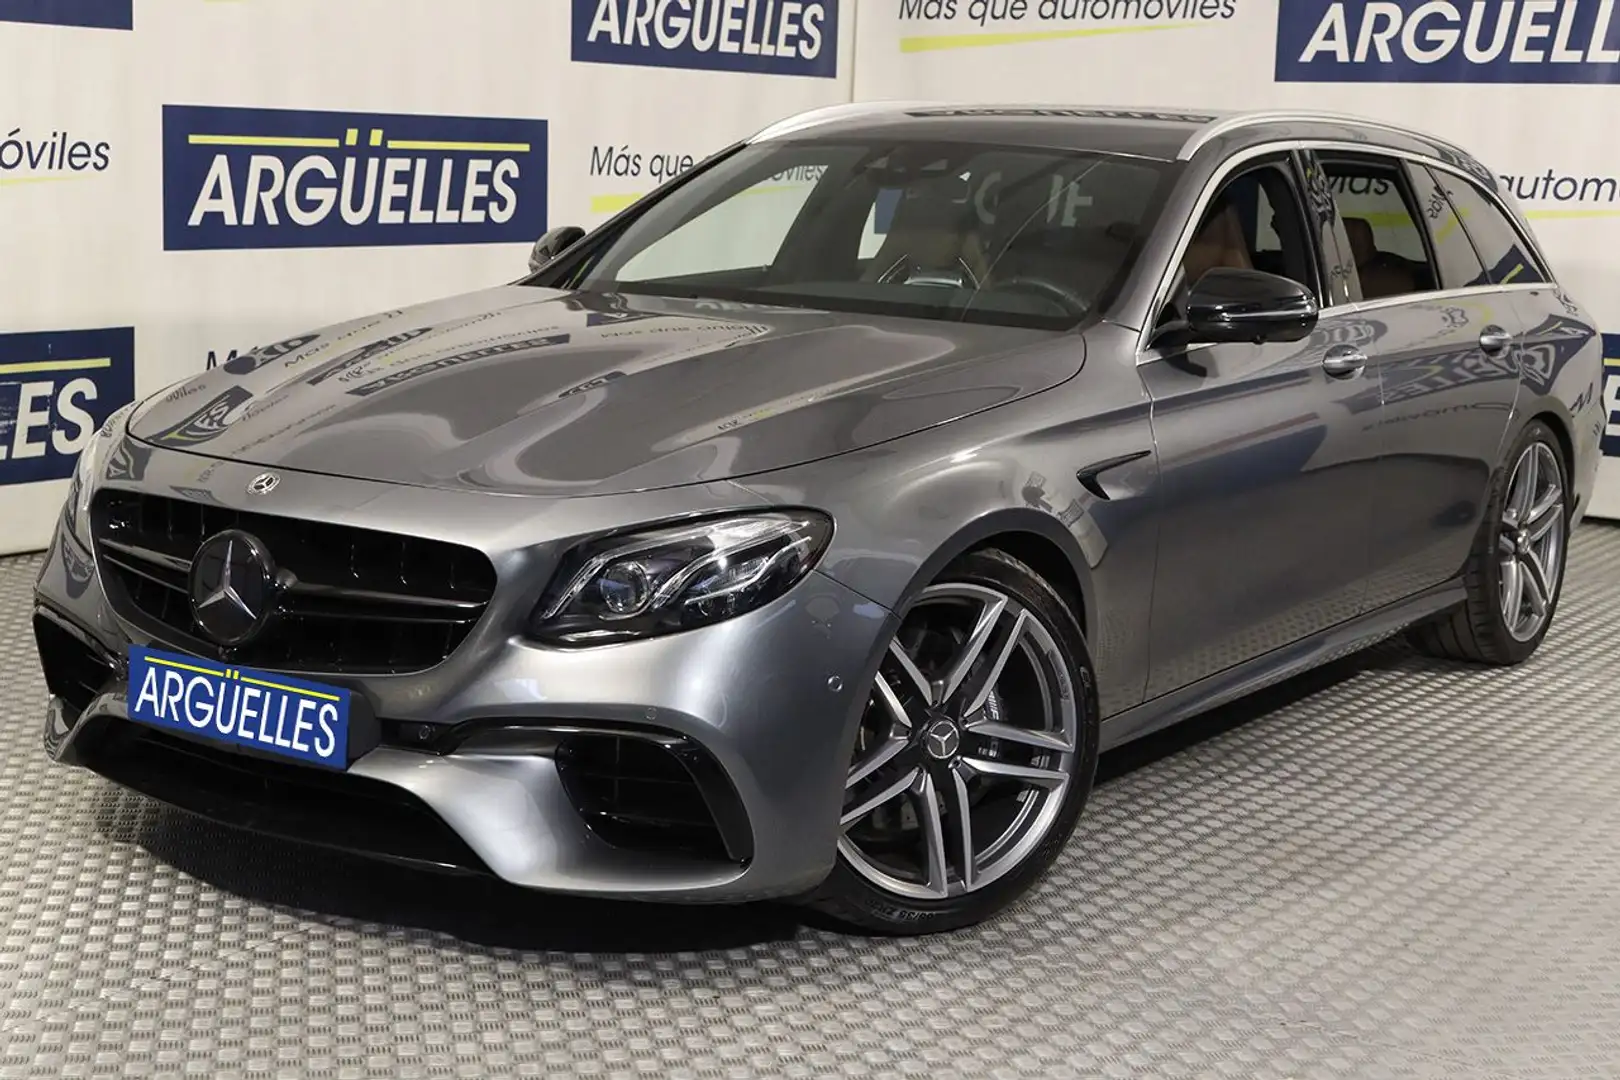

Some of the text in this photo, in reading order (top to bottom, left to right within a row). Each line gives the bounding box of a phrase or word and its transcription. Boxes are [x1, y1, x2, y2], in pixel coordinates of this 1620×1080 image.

[968, 0, 1028, 27] que
[0, 128, 110, 171] óviles
[188, 128, 519, 226] ARGÜELLES
[590, 145, 642, 177] Más
[649, 154, 694, 184] que
[0, 377, 98, 460] ES
[134, 666, 338, 758] ARGÜELLES
